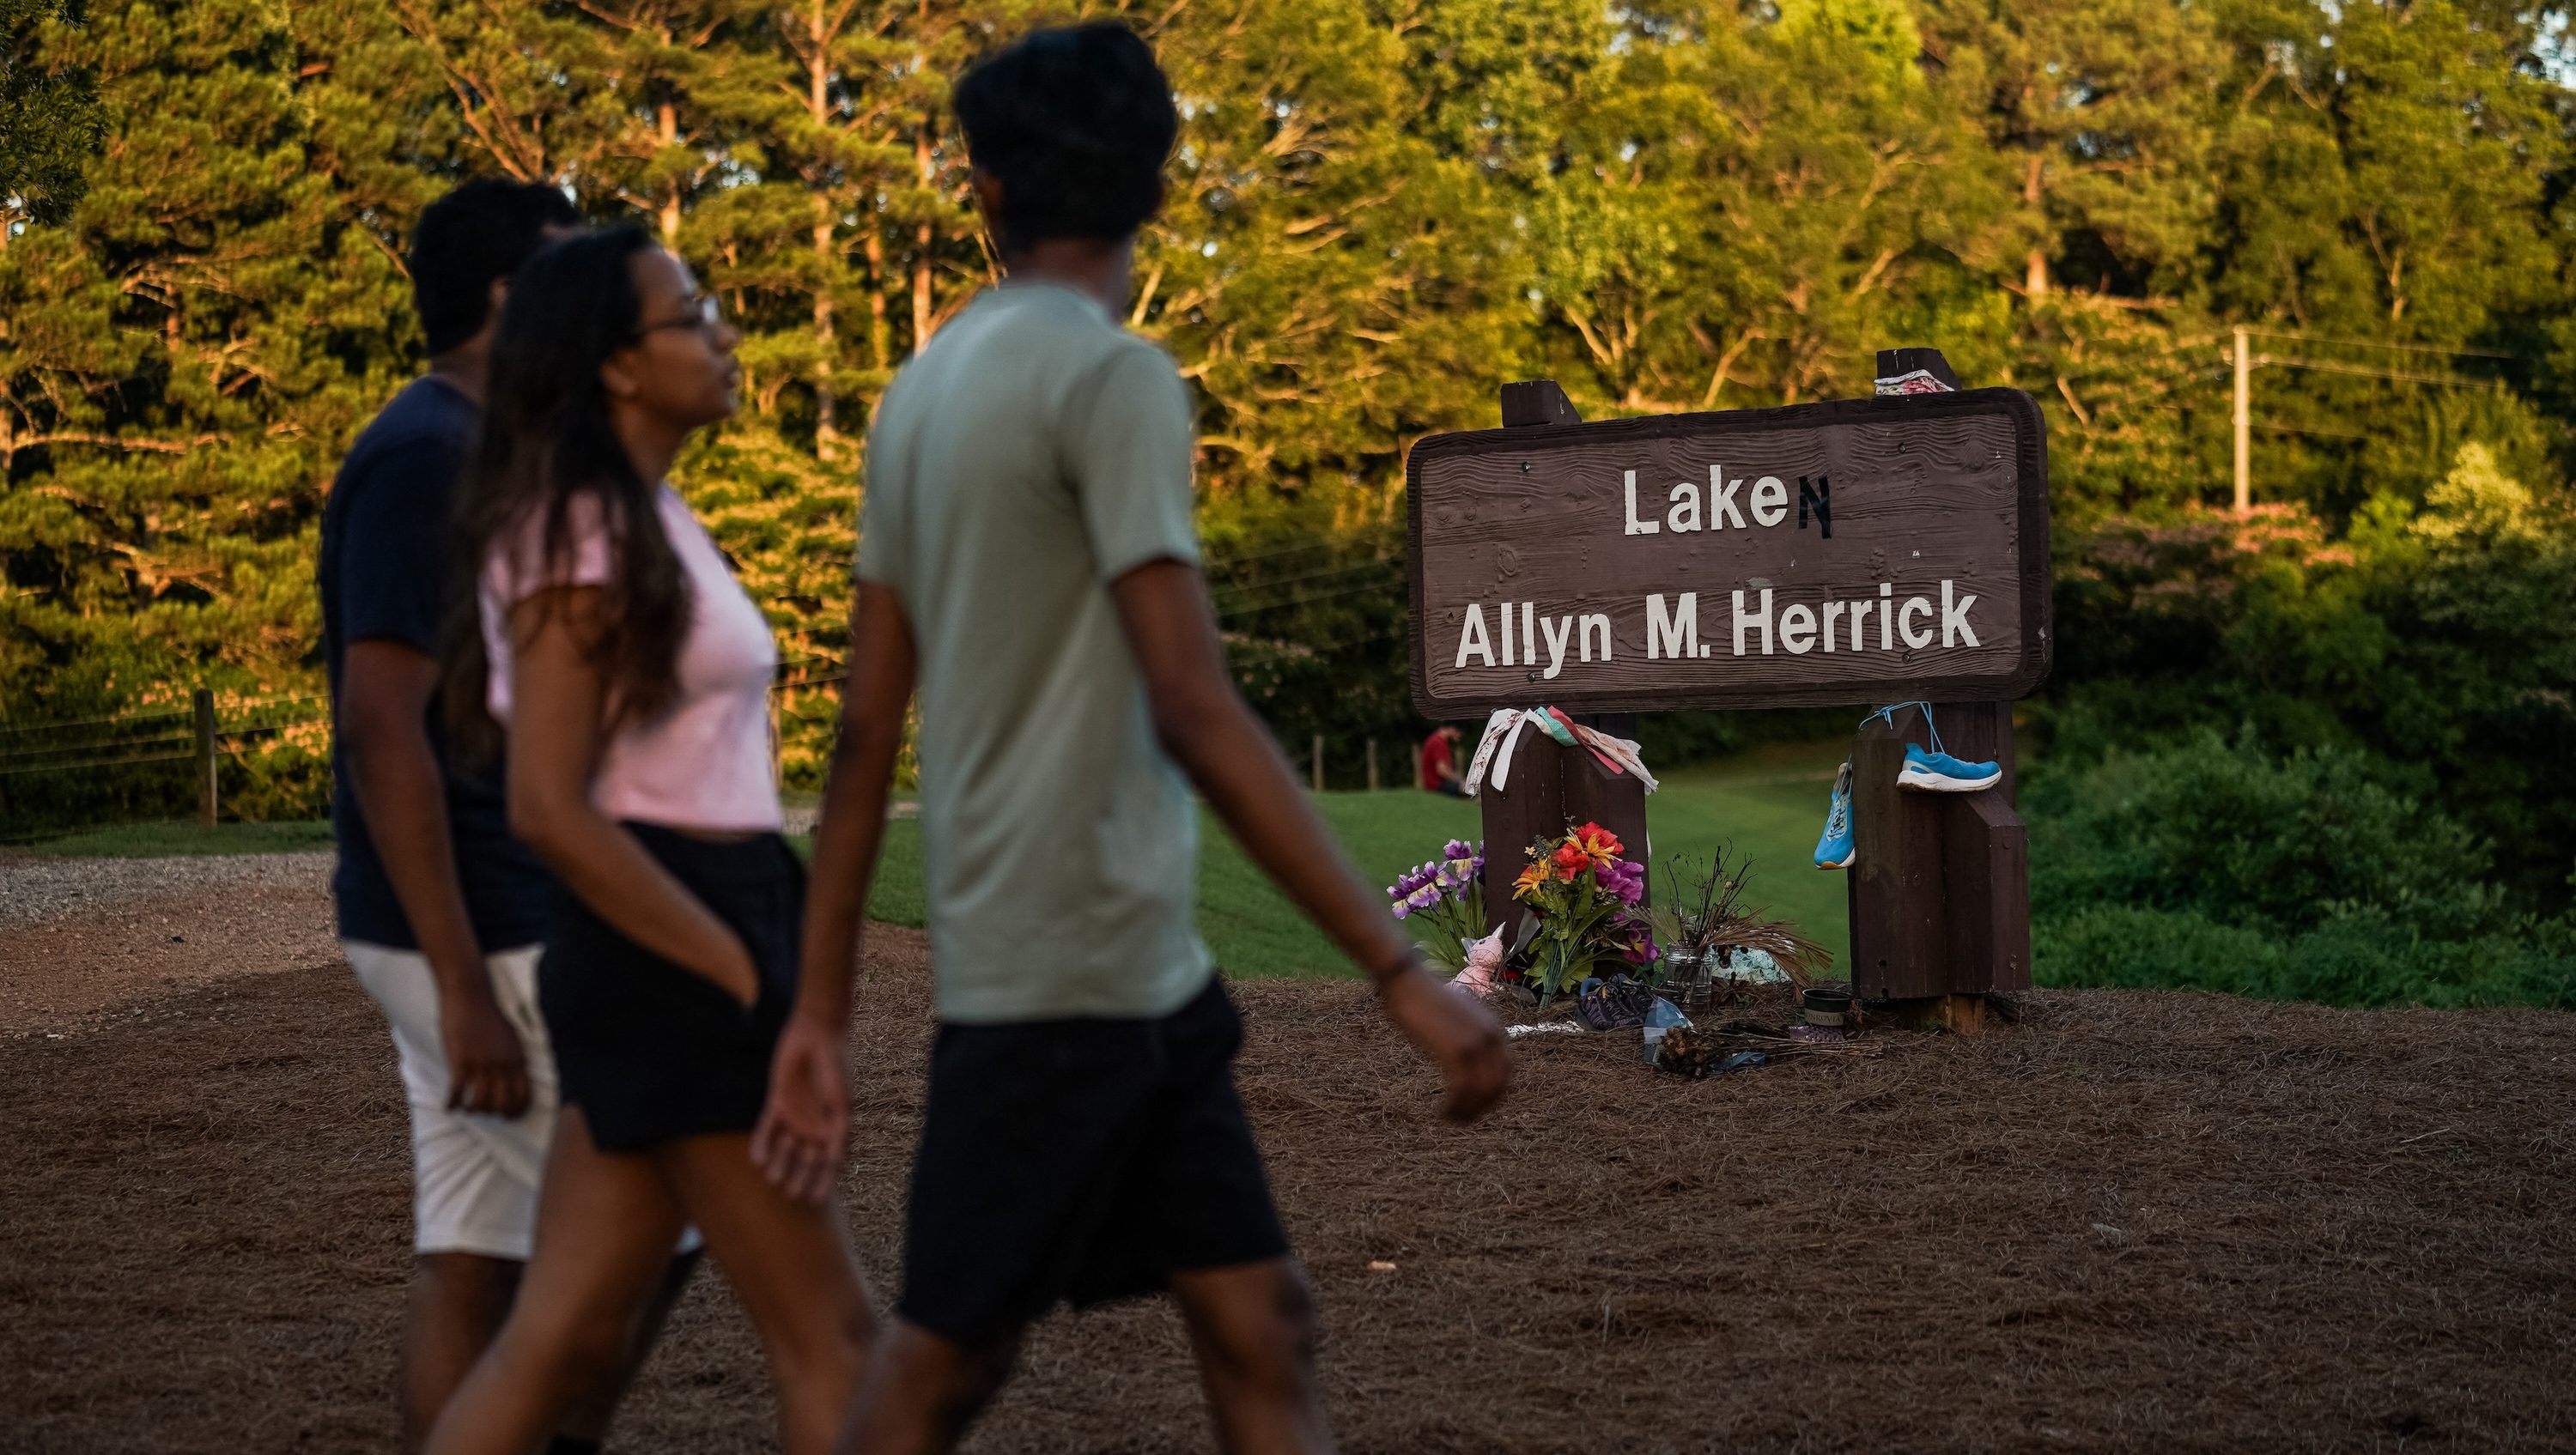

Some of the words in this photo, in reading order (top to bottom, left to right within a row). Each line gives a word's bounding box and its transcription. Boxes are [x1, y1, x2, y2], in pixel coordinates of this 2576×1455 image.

[1455, 602, 1612, 680] Allyn
[1646, 592, 1710, 659] M.
[1732, 579, 1981, 656] Herrick
